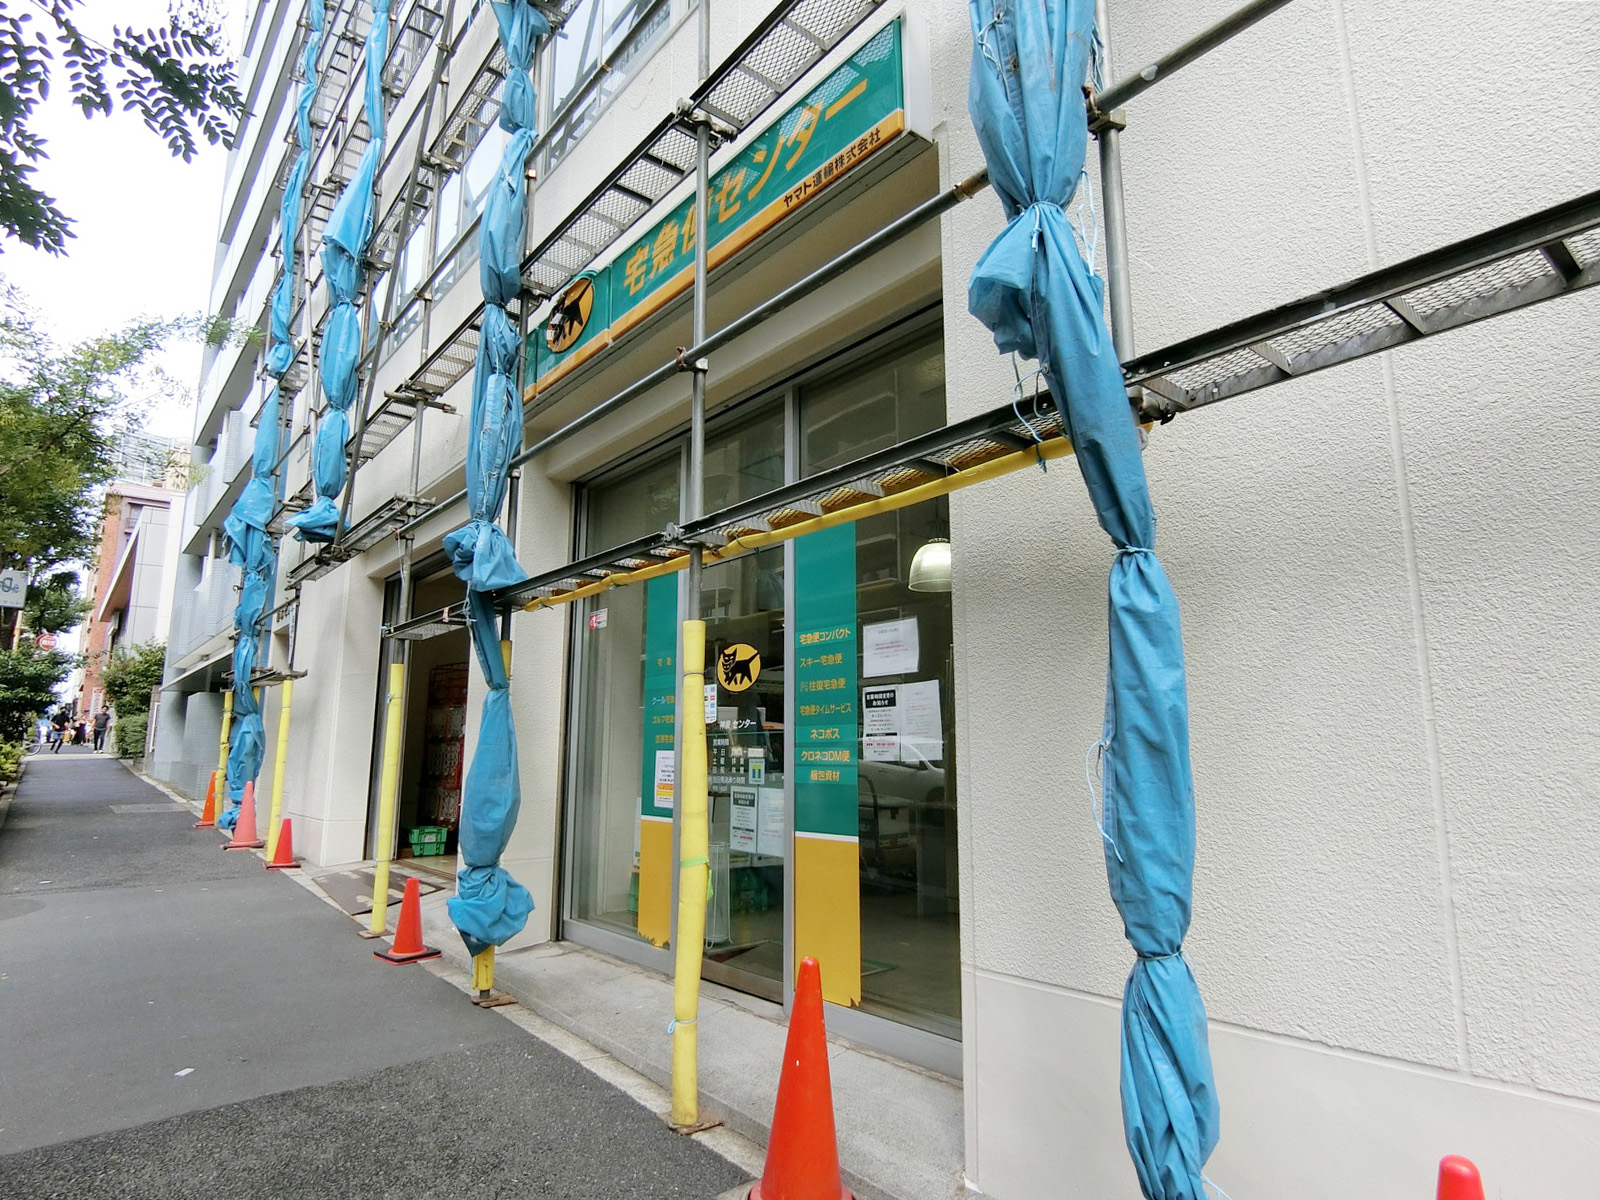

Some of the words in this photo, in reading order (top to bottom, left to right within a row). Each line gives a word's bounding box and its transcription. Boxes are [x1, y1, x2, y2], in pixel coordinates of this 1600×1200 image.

[783, 127, 881, 208] ヤマト運輸株式会社
[800, 628, 851, 645] 宅急便コンパクト
[800, 653, 843, 668] スキー宅急便
[800, 703, 852, 716] 宅急便タイムサービス
[732, 718, 757, 729] センター
[810, 727, 841, 739] ネコポス
[801, 750, 850, 762] クロネコDM便
[810, 769, 840, 781] 梱包資材
